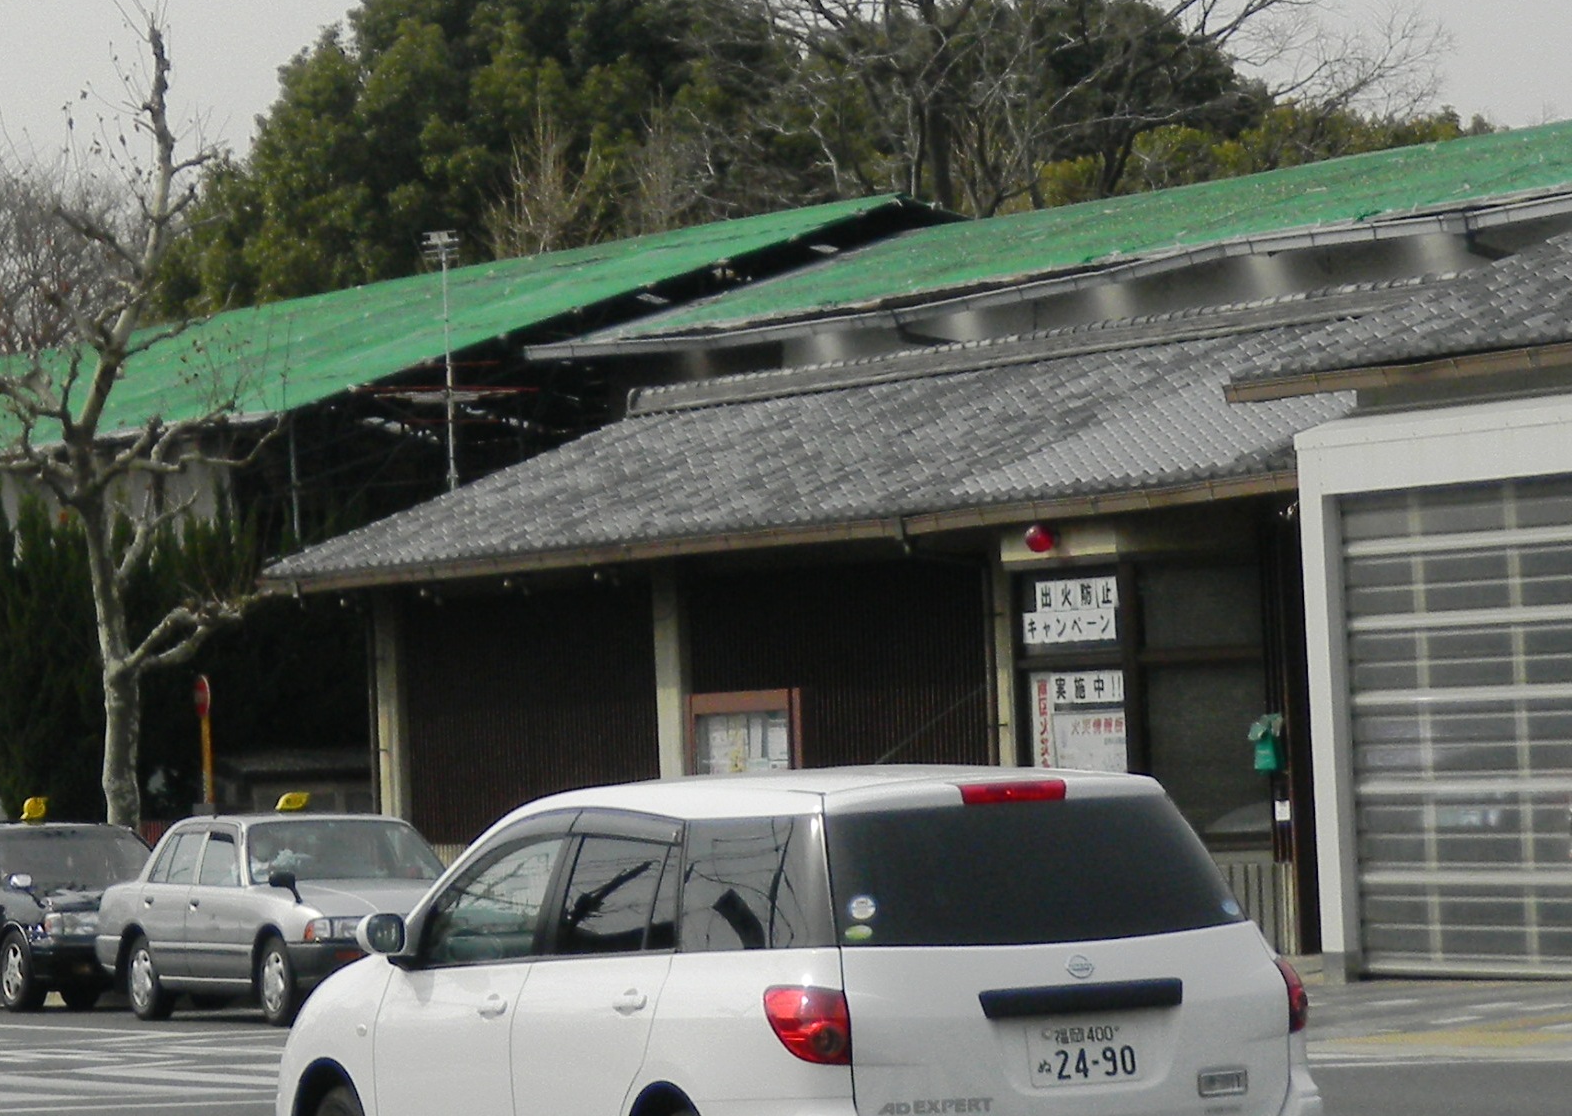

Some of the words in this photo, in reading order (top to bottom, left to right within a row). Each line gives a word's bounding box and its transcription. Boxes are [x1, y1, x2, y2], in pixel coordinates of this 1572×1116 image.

[1040, 582, 1113, 608] 出火防止
[1027, 614, 1111, 639] キャンペーン
[1055, 1044, 1137, 1080] 24-90
[878, 1102, 911, 1115] AD
[914, 1097, 993, 1114] EXPERT
